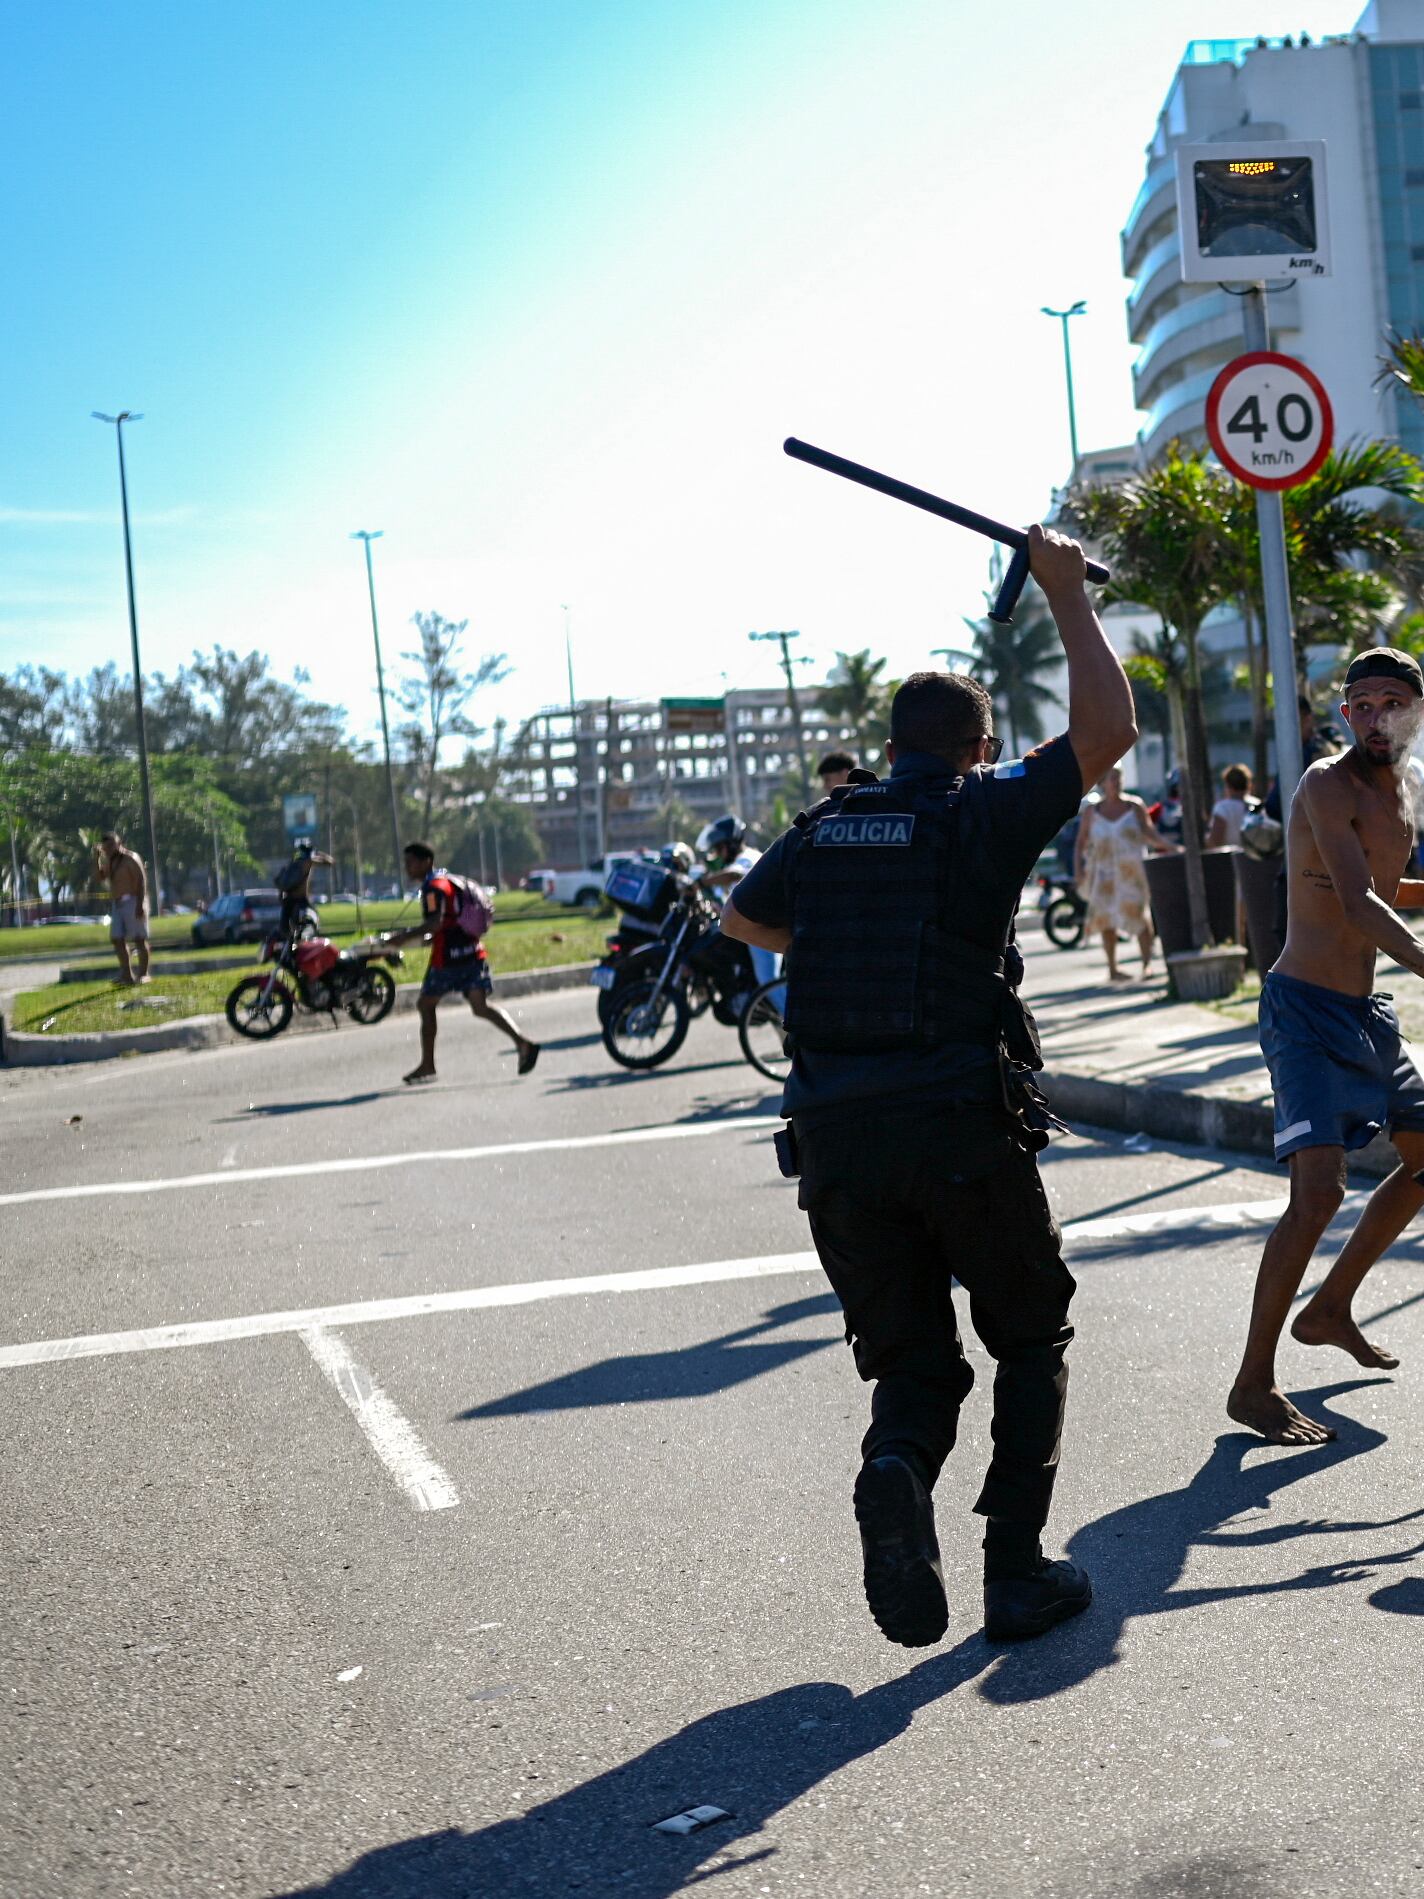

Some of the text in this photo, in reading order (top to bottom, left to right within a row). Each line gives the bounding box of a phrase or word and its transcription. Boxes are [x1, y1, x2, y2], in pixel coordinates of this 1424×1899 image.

[1226, 393, 1314, 444] 40
[1251, 449, 1295, 467] km/h
[816, 818, 909, 843] POLÍCIA
